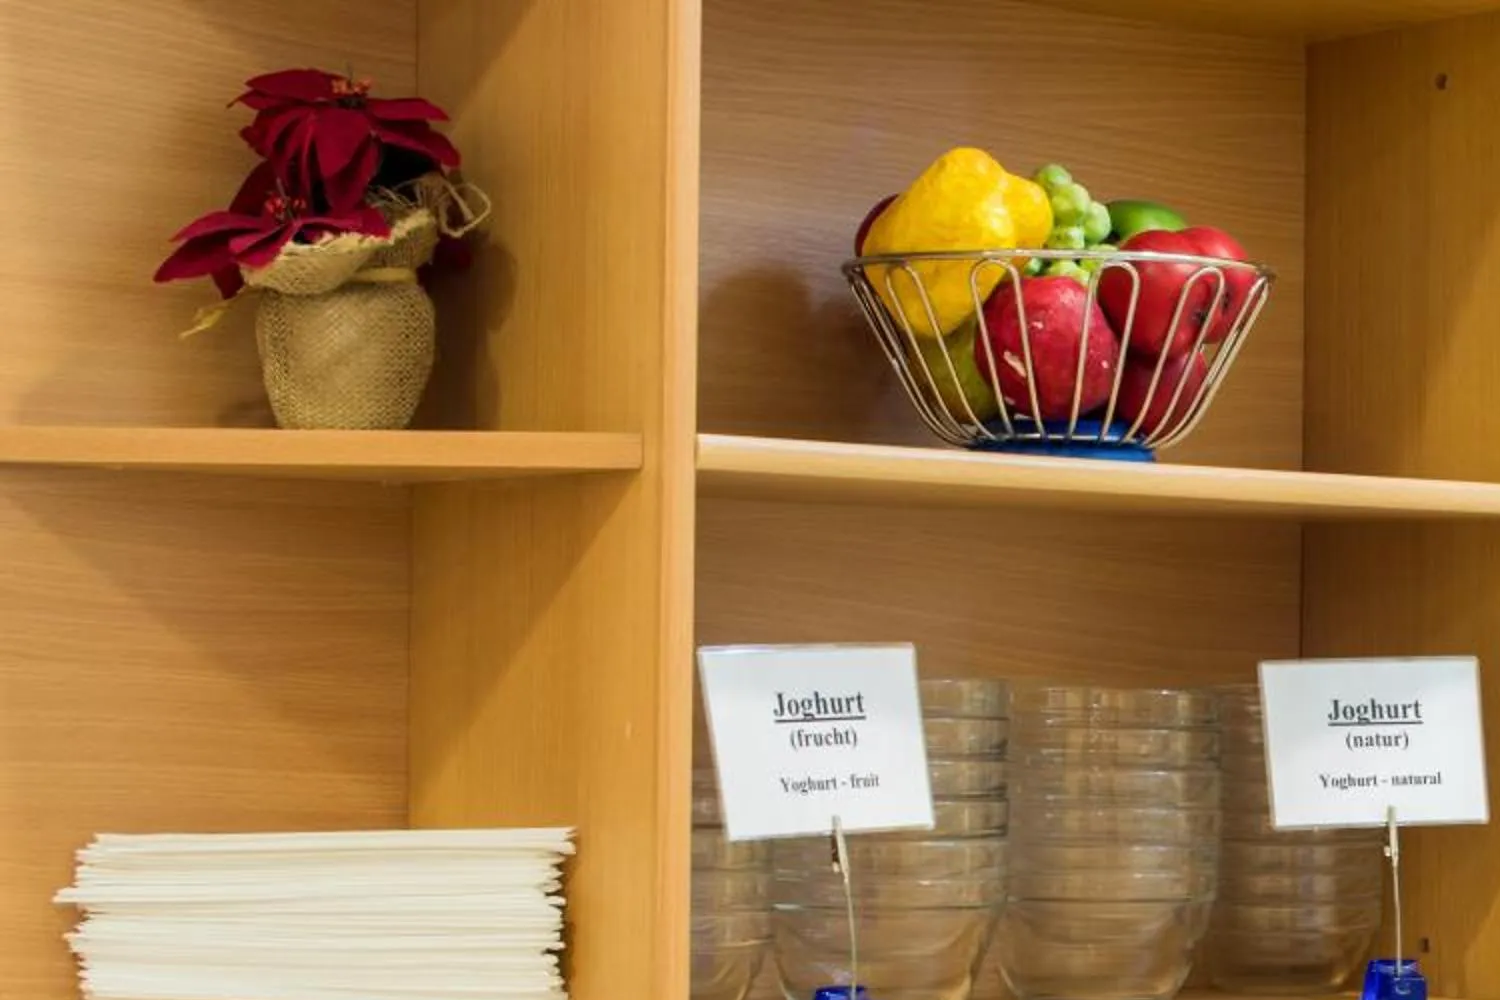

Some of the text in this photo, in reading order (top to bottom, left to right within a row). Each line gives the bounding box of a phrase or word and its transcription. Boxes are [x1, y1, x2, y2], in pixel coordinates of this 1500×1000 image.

[773, 690, 866, 722] Joghurt
[1327, 698, 1423, 726] Joghurt
[790, 727, 858, 750] (frucht)
[1345, 731, 1410, 751] (natur)
[780, 775, 838, 795] Yoghurt
[850, 772, 880, 789] fruit
[1319, 773, 1378, 790] Yoghurt
[1391, 771, 1442, 786] natural
